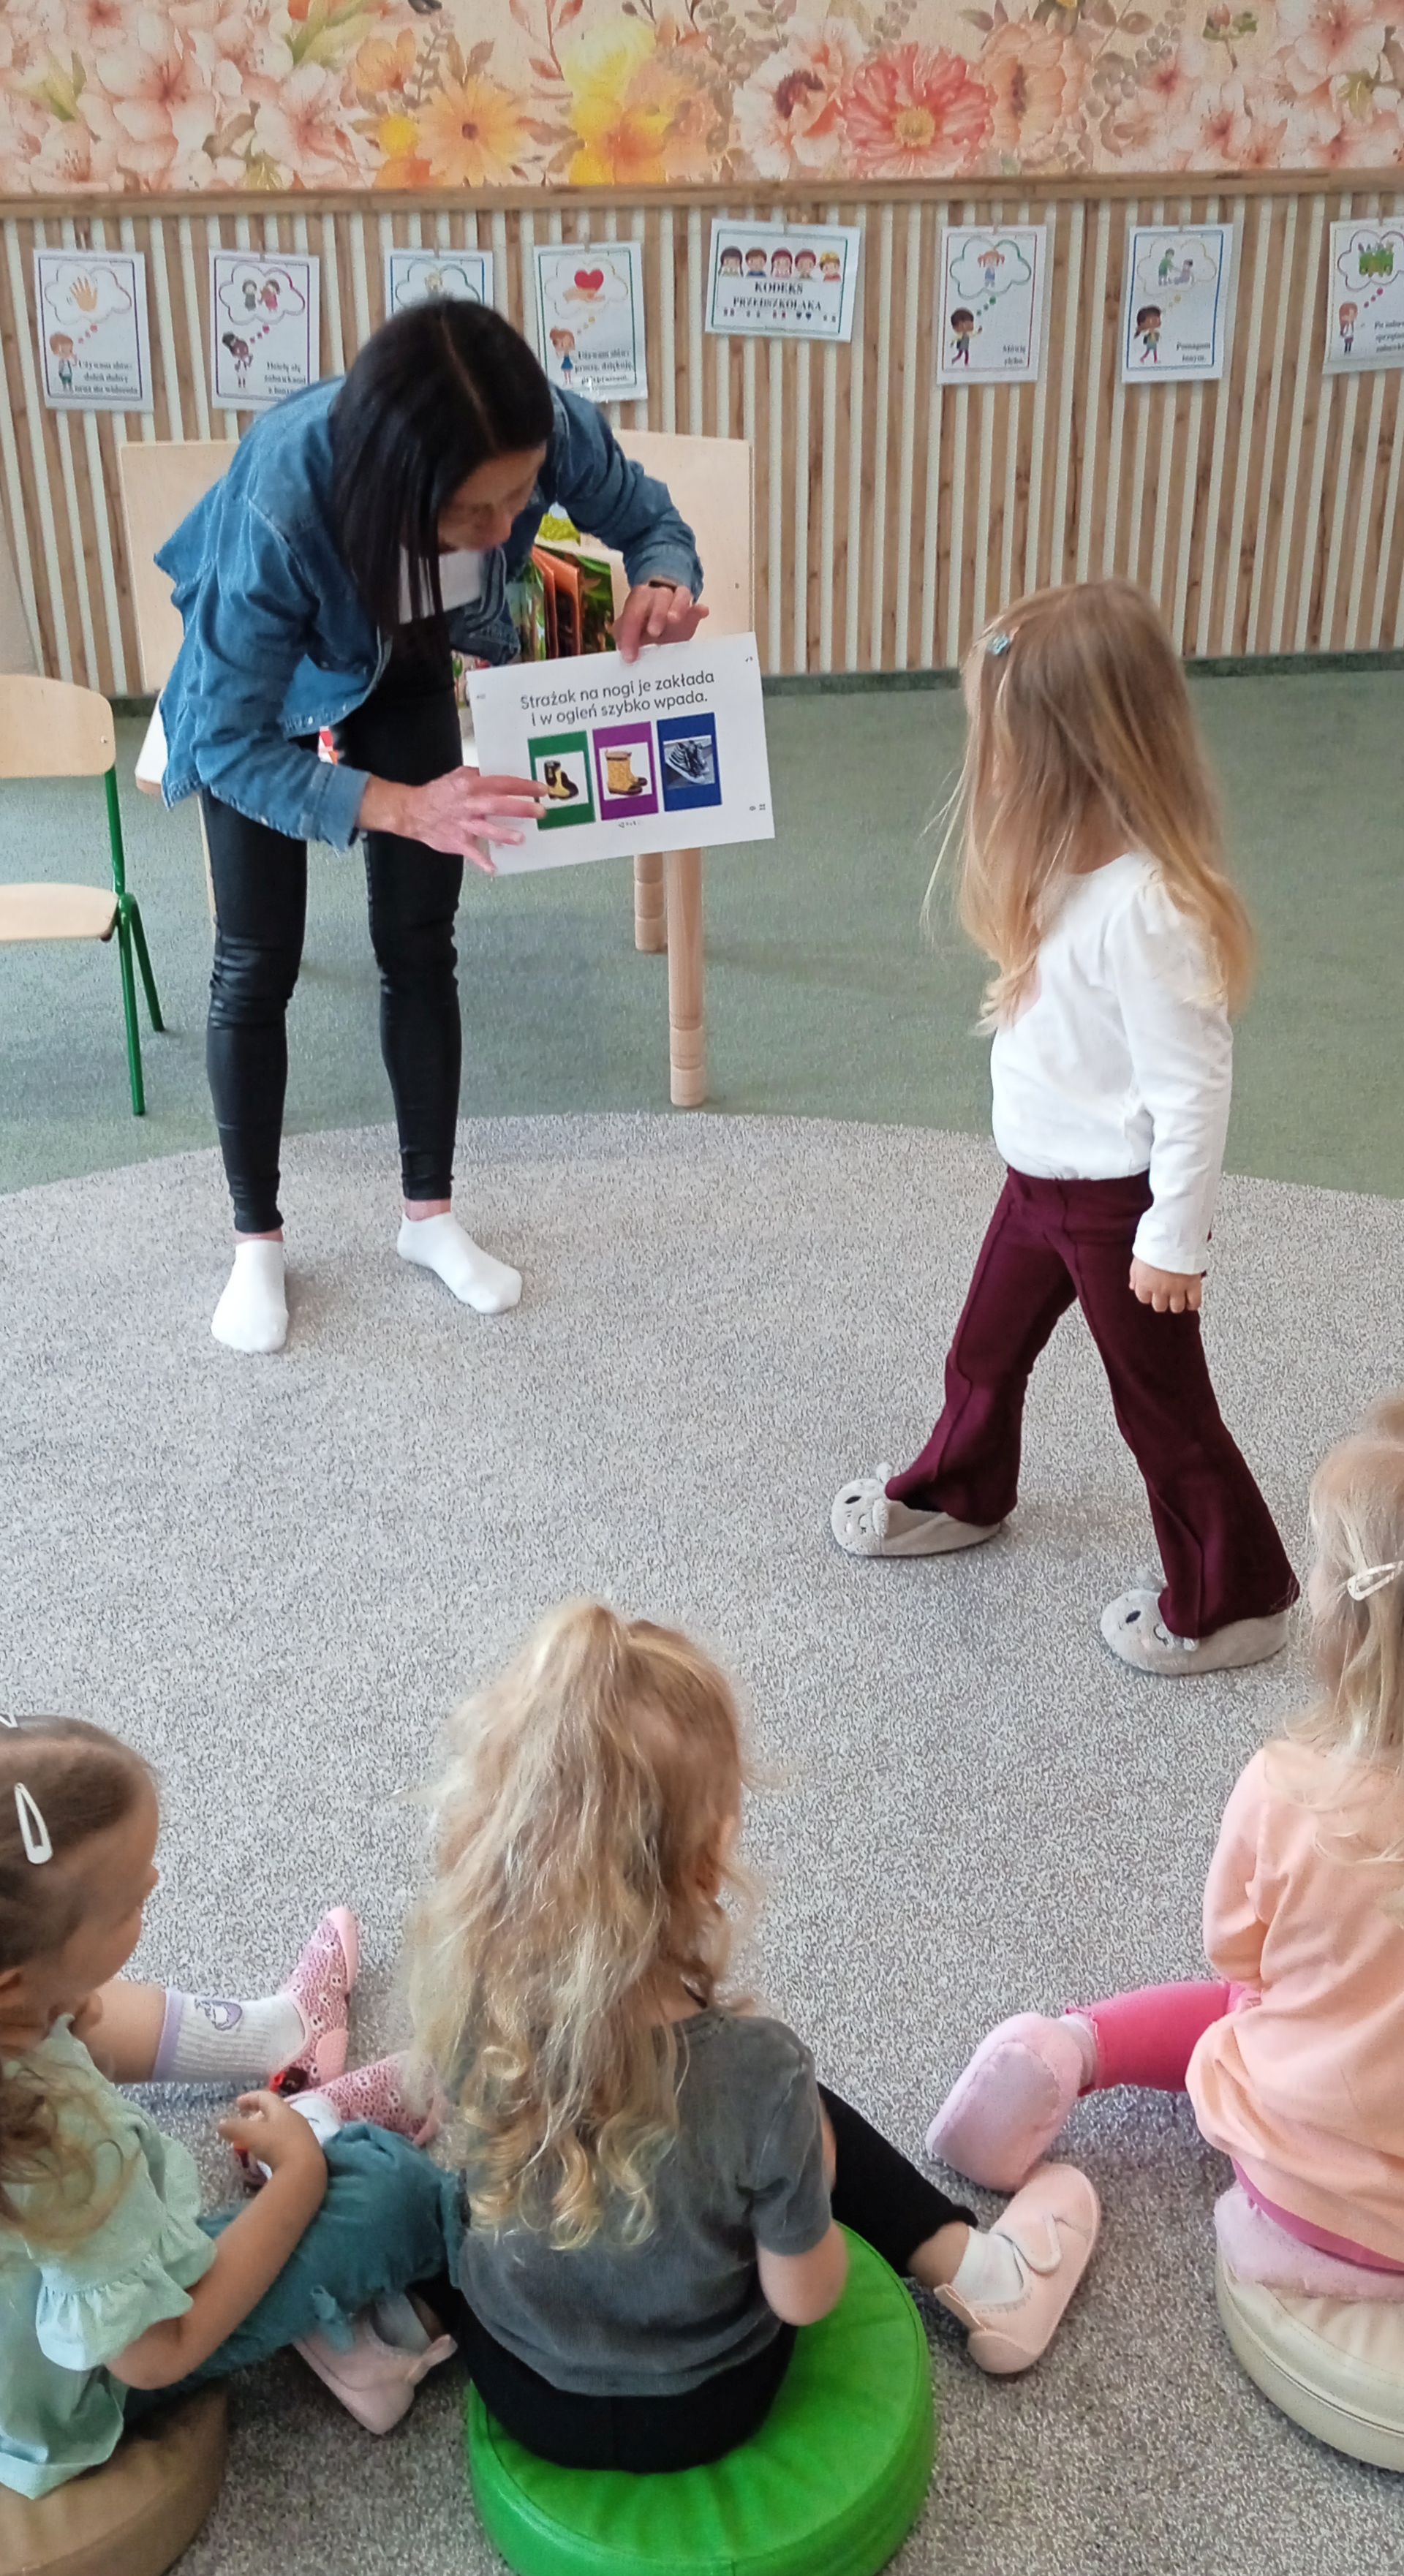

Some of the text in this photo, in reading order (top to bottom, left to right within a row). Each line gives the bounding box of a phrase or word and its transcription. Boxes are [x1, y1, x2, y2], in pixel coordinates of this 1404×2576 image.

[755, 282, 804, 295] KODEKS
[733, 296, 821, 311] PRZEDSZKOLAKA
[521, 671, 714, 710] Strażak na nogi je zakłada
[532, 691, 709, 726] i w ogień szybko wpada.
